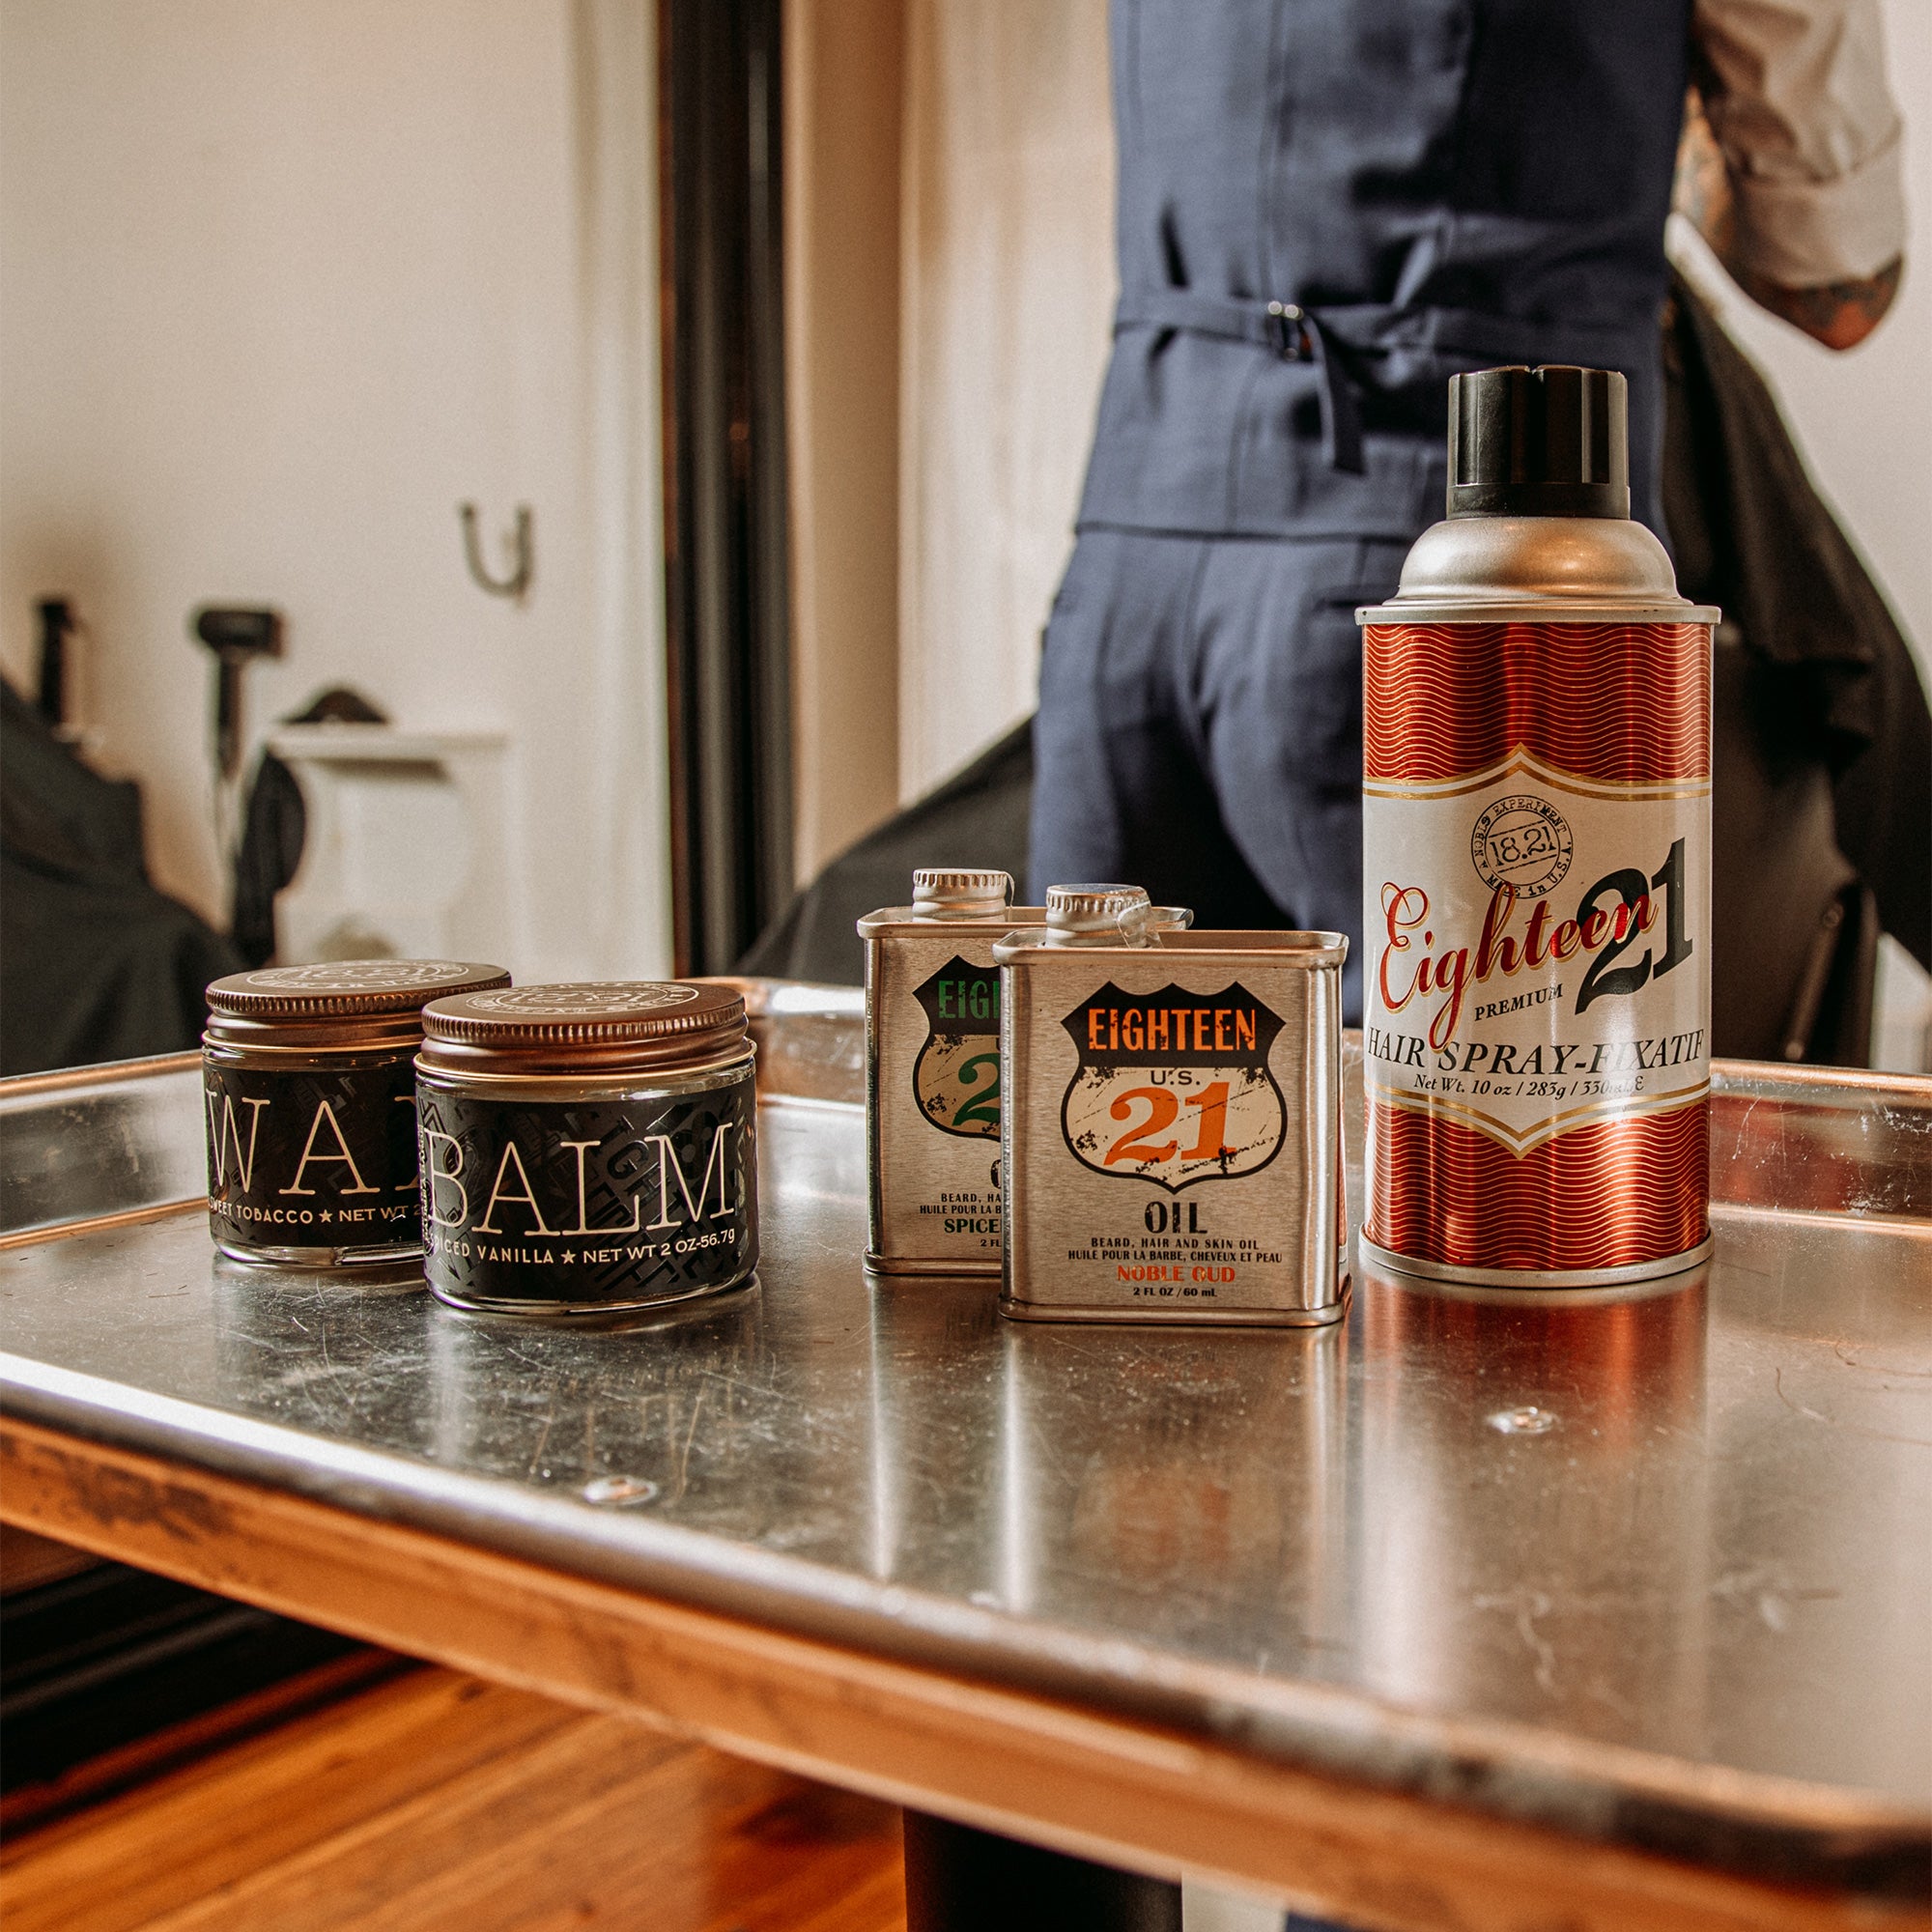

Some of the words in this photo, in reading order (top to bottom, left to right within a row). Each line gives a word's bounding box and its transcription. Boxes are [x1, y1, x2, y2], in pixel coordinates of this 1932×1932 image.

[1492, 799, 1567, 833] EXPERIMENT
[1489, 826, 1557, 867] 18.21
[1528, 884, 1547, 897] in
[1575, 837, 1693, 1015] 21
[1379, 881, 1659, 1054] Eighteen
[1475, 983, 1563, 1021] PREMIUM
[1088, 1009, 1256, 1051] EIGHTEEN
[1368, 1027, 1425, 1067] HAIR
[1150, 1070, 1201, 1086] U.S.
[1414, 1074, 1436, 1090] Net
[1441, 1077, 1464, 1093] Wt.
[1470, 1080, 1491, 1094] 10
[1493, 1084, 1512, 1095] oz
[1526, 1081, 1567, 1100] 283g
[1580, 1079, 1634, 1096] 330
[1103, 1082, 1237, 1166] 21
[424, 1122, 734, 1236] BALM
[941, 1193, 981, 1203] BEARD,
[236, 1205, 313, 1224] TOBACCO
[339, 1208, 376, 1222] NET
[380, 1205, 409, 1221] WT
[920, 1205, 948, 1214] HUILE
[951, 1205, 977, 1214] POUR
[980, 1205, 992, 1214] LA
[1144, 1201, 1208, 1235] OIL
[944, 1218, 1002, 1234] SPICE
[583, 1247, 622, 1264] NET
[626, 1244, 657, 1260] WT
[661, 1242, 671, 1256] 2
[675, 1228, 735, 1253] OZ-56.7g
[980, 1238, 987, 1247] 2
[1091, 1237, 1135, 1249] BEARD,
[1141, 1238, 1170, 1249] HAIR
[1175, 1238, 1199, 1249] AND
[1205, 1239, 1234, 1250] SKIN
[1239, 1239, 1260, 1250] OIL
[477, 1245, 554, 1264] VANILLA
[1067, 1250, 1098, 1261] HUILE
[1102, 1250, 1131, 1261] POUR
[1133, 1251, 1146, 1262] LA
[1150, 1251, 1186, 1263] BARBE,
[1190, 1252, 1236, 1263] CHEVEUX
[1239, 1253, 1252, 1263] ET
[1256, 1253, 1283, 1263] PEAU
[1117, 1264, 1184, 1282] NOBLE
[1191, 1265, 1236, 1283] OUD
[1133, 1287, 1141, 1296] 2
[1144, 1288, 1157, 1296] FL
[1159, 1288, 1174, 1296] OZ
